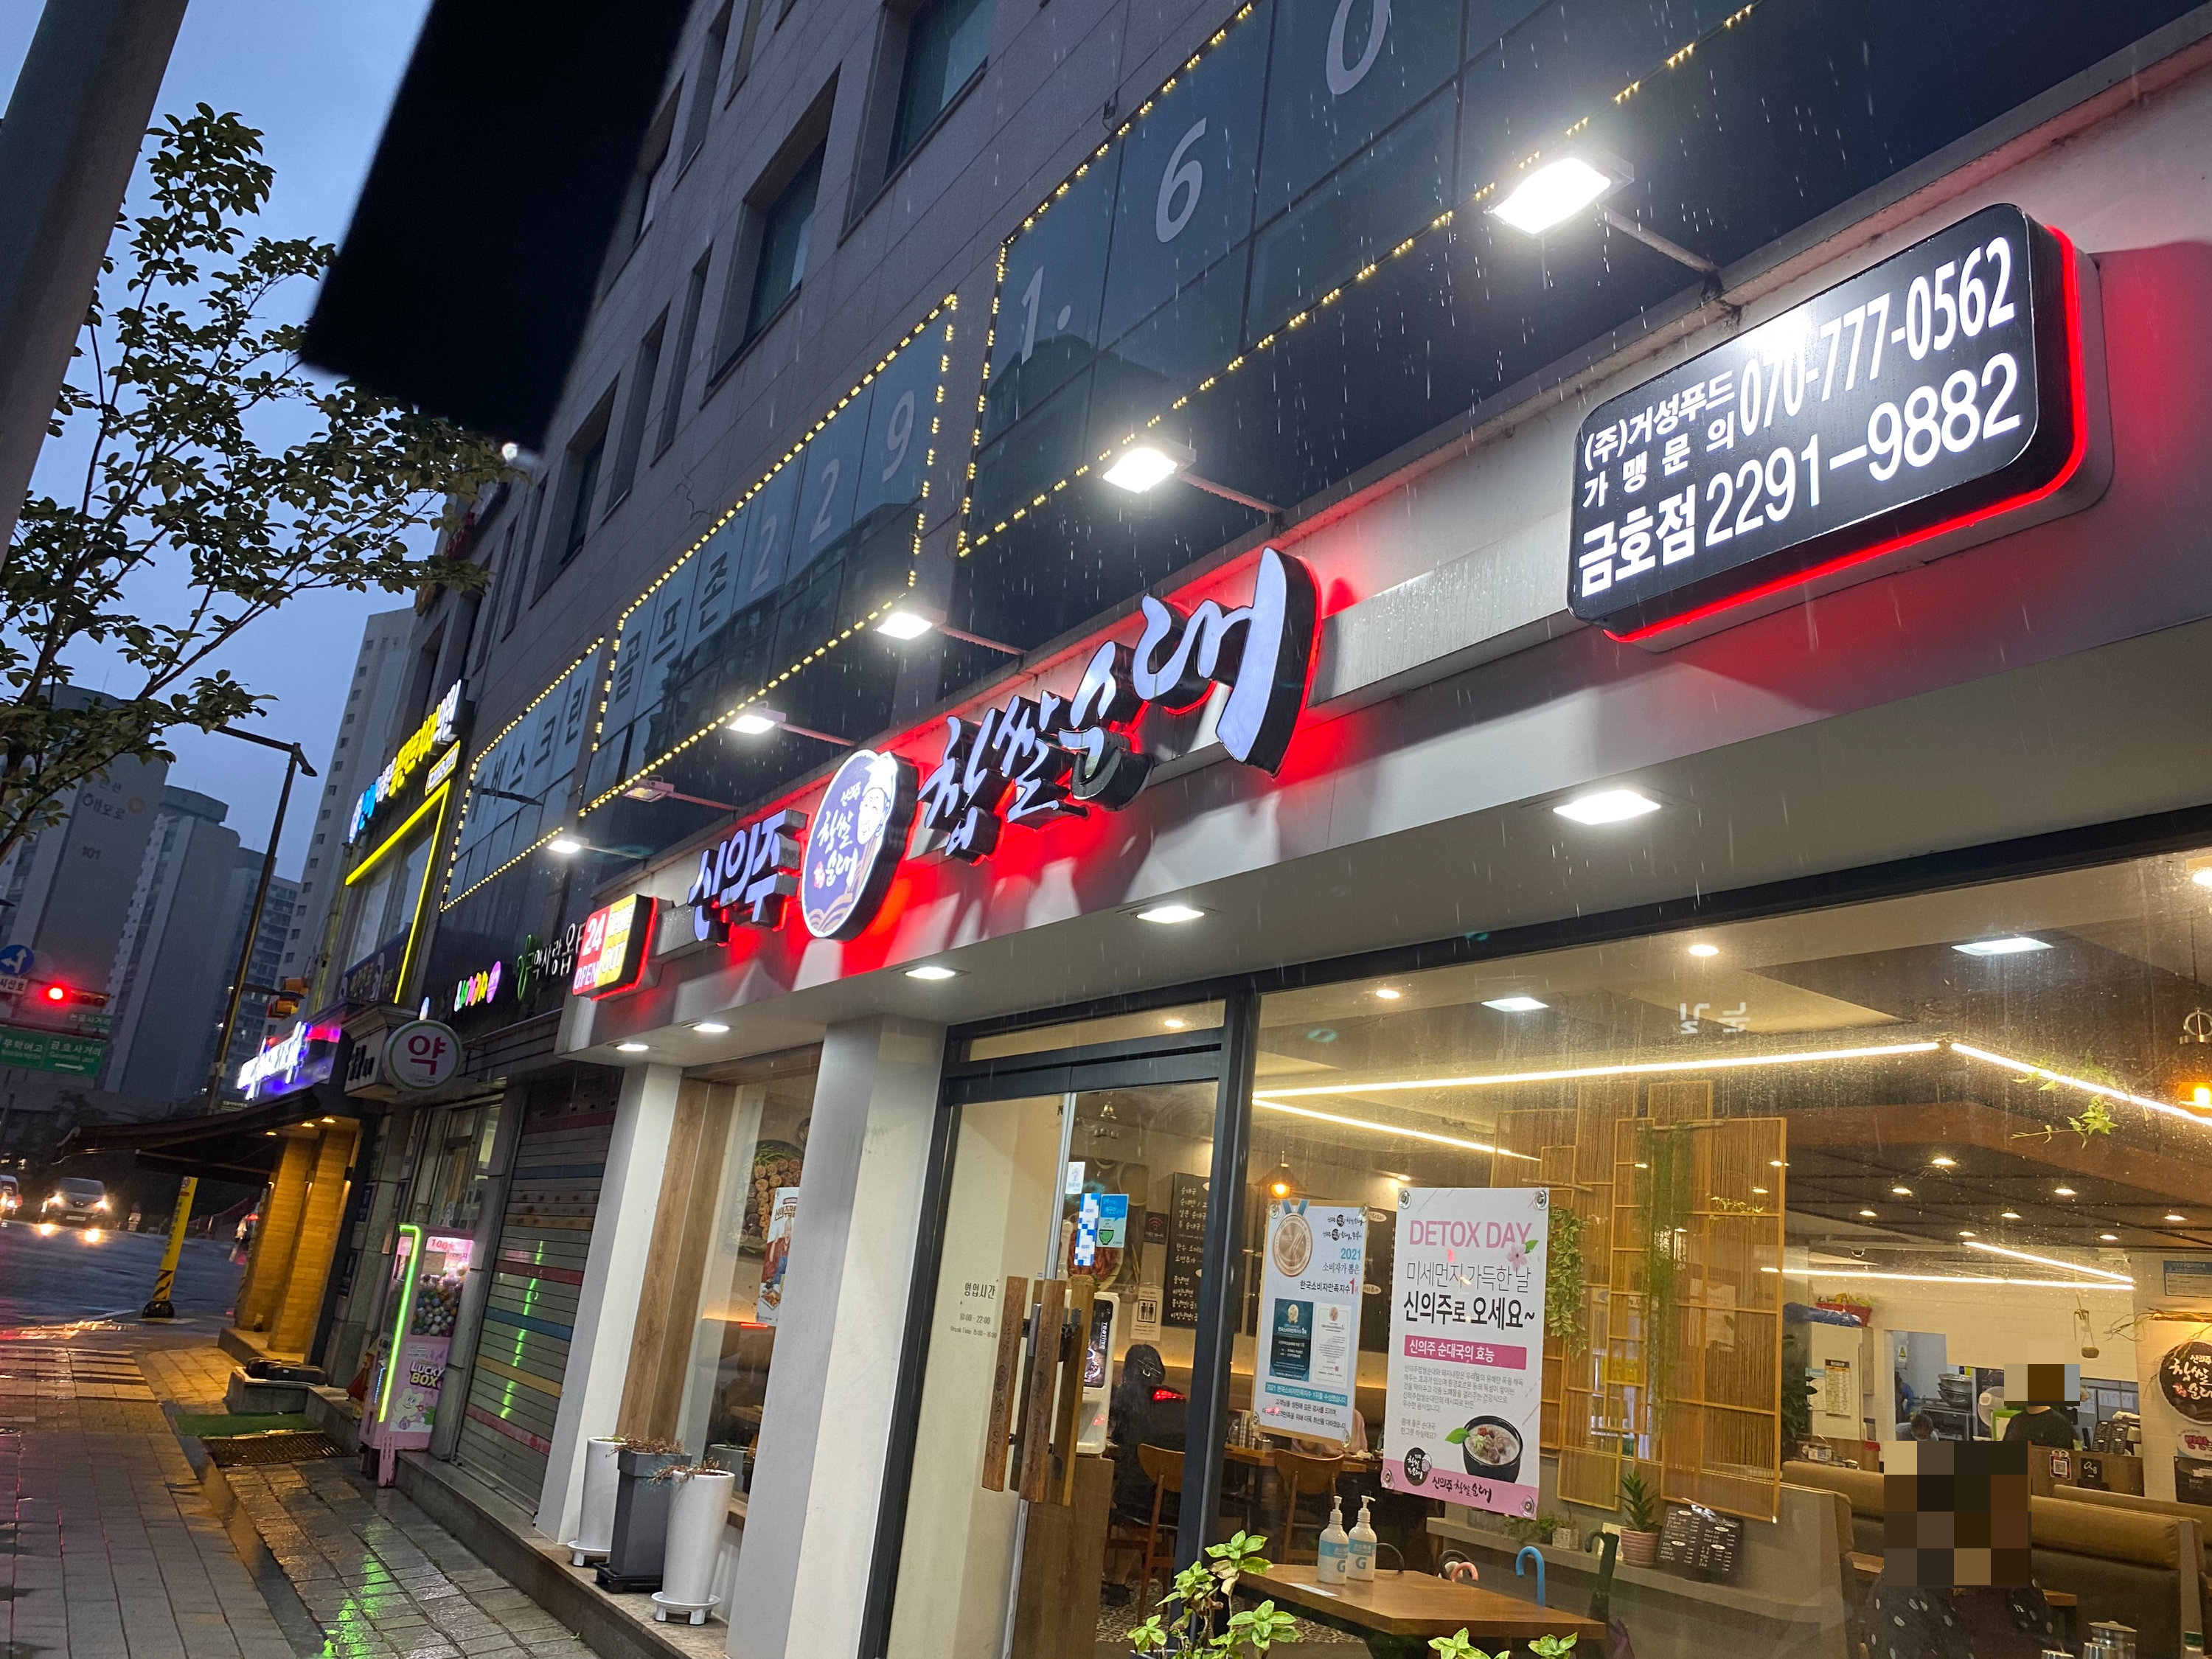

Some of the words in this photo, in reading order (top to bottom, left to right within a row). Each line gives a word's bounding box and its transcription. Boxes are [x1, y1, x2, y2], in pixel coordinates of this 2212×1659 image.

[1584, 370, 1736, 473] (주)거성푸드
[1739, 237, 2014, 437] 070-777-0562
[1578, 484, 1697, 598] 금호점
[1705, 352, 2023, 549] 2291-9882
[687, 808, 792, 942] 신의주
[582, 911, 607, 957] 24
[607, 902, 634, 938] TAKE
[600, 939, 627, 974] OUT
[574, 960, 599, 990] OPEN
[407, 1034, 447, 1077] 약
[1408, 1220, 1481, 1248] DETOX
[1486, 1222, 1533, 1249] DAY
[1321, 1262, 1347, 1273] 소비자가
[1348, 1263, 1360, 1275] 뽑은
[1340, 1247, 1361, 1261] 2021
[964, 1282, 995, 1299] 영업시간
[1406, 1260, 1464, 1289] 미세먼지
[1467, 1264, 1512, 1292] 가득한
[1514, 1266, 1531, 1293] 날
[959, 1312, 973, 1322] 10:00
[976, 1315, 991, 1325] 22:00
[1403, 1290, 1467, 1325] 신의주로
[1470, 1296, 1535, 1331] 오세요~
[950, 1325, 961, 1333] Break
[1409, 1339, 1436, 1355] 신의주
[1437, 1343, 1474, 1360] 순대국의
[1475, 1346, 1495, 1363] 효능
[410, 1360, 446, 1377] LUCKY
[411, 1371, 439, 1388] BOX
[1431, 1476, 1453, 1492] 신의주
[1355, 1556, 1367, 1570] G
